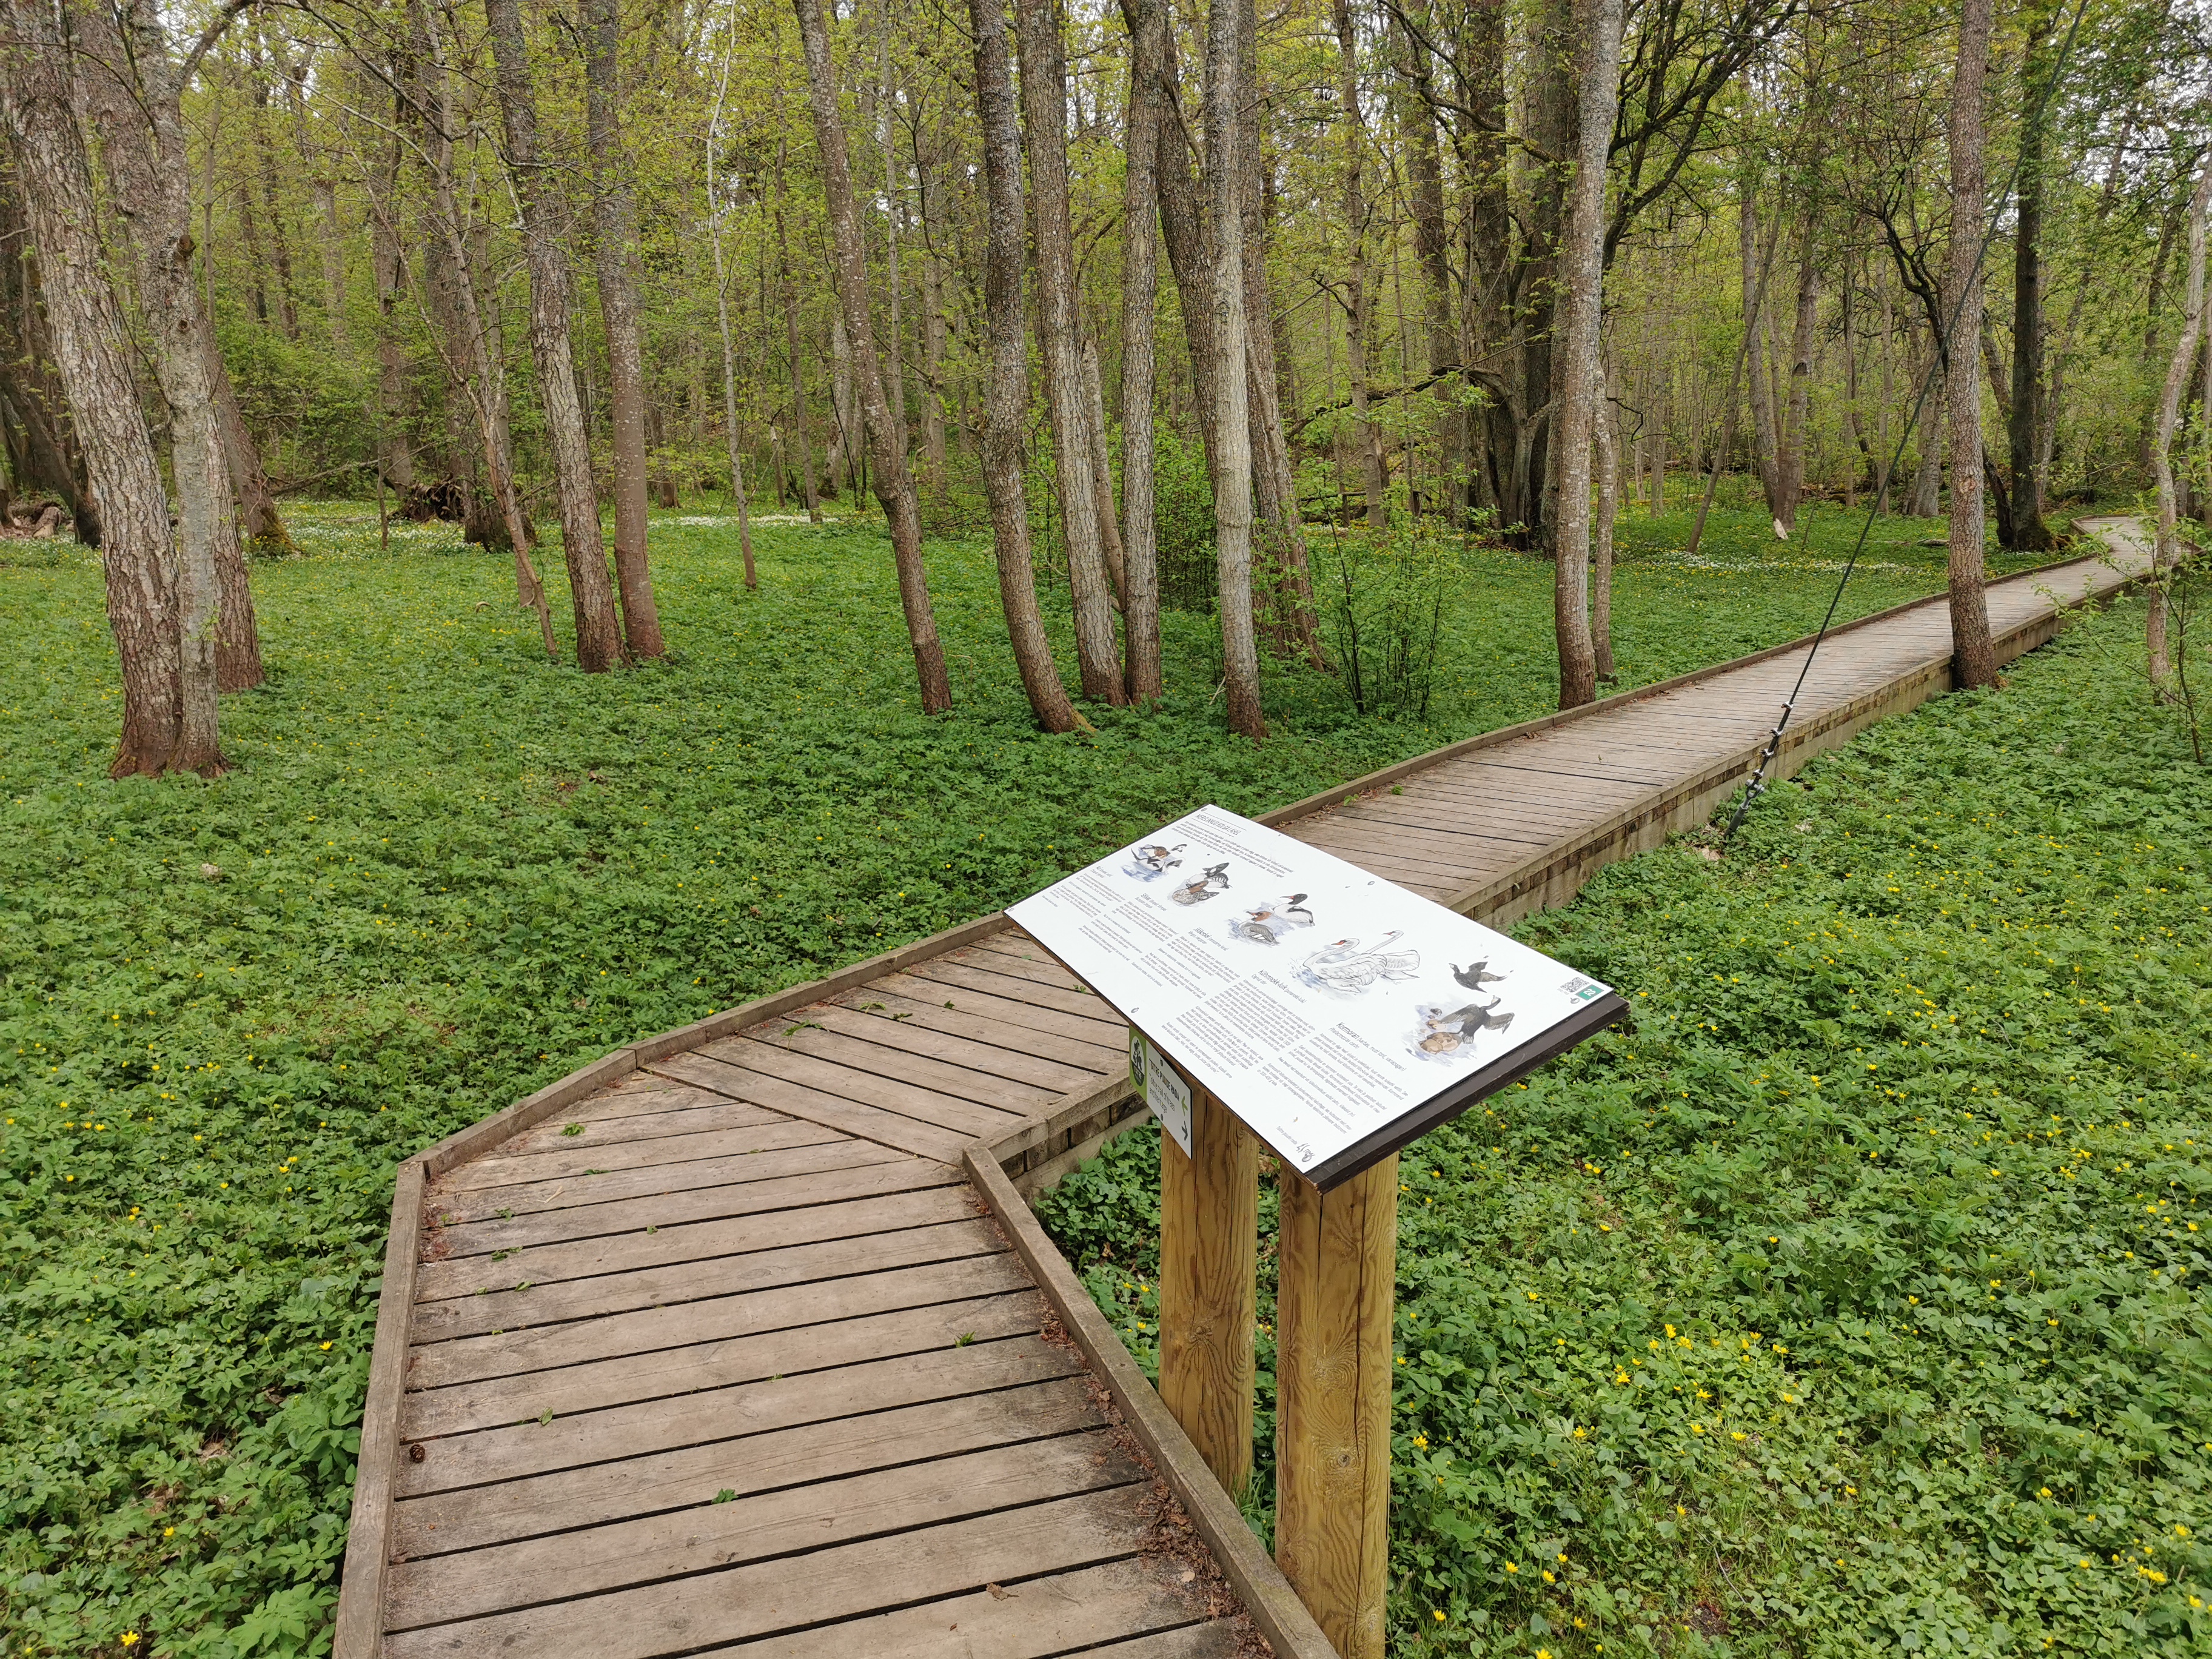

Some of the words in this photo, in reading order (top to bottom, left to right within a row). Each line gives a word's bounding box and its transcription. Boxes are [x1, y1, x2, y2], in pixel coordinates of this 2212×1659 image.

[1258, 969, 1288, 990] Kühmnokk-luik
[1336, 1022, 1359, 1039] Kormoran
[1155, 1091, 1167, 1113] heritage
[1163, 1093, 1167, 1102] of
[1170, 1084, 1179, 1102] RADA
